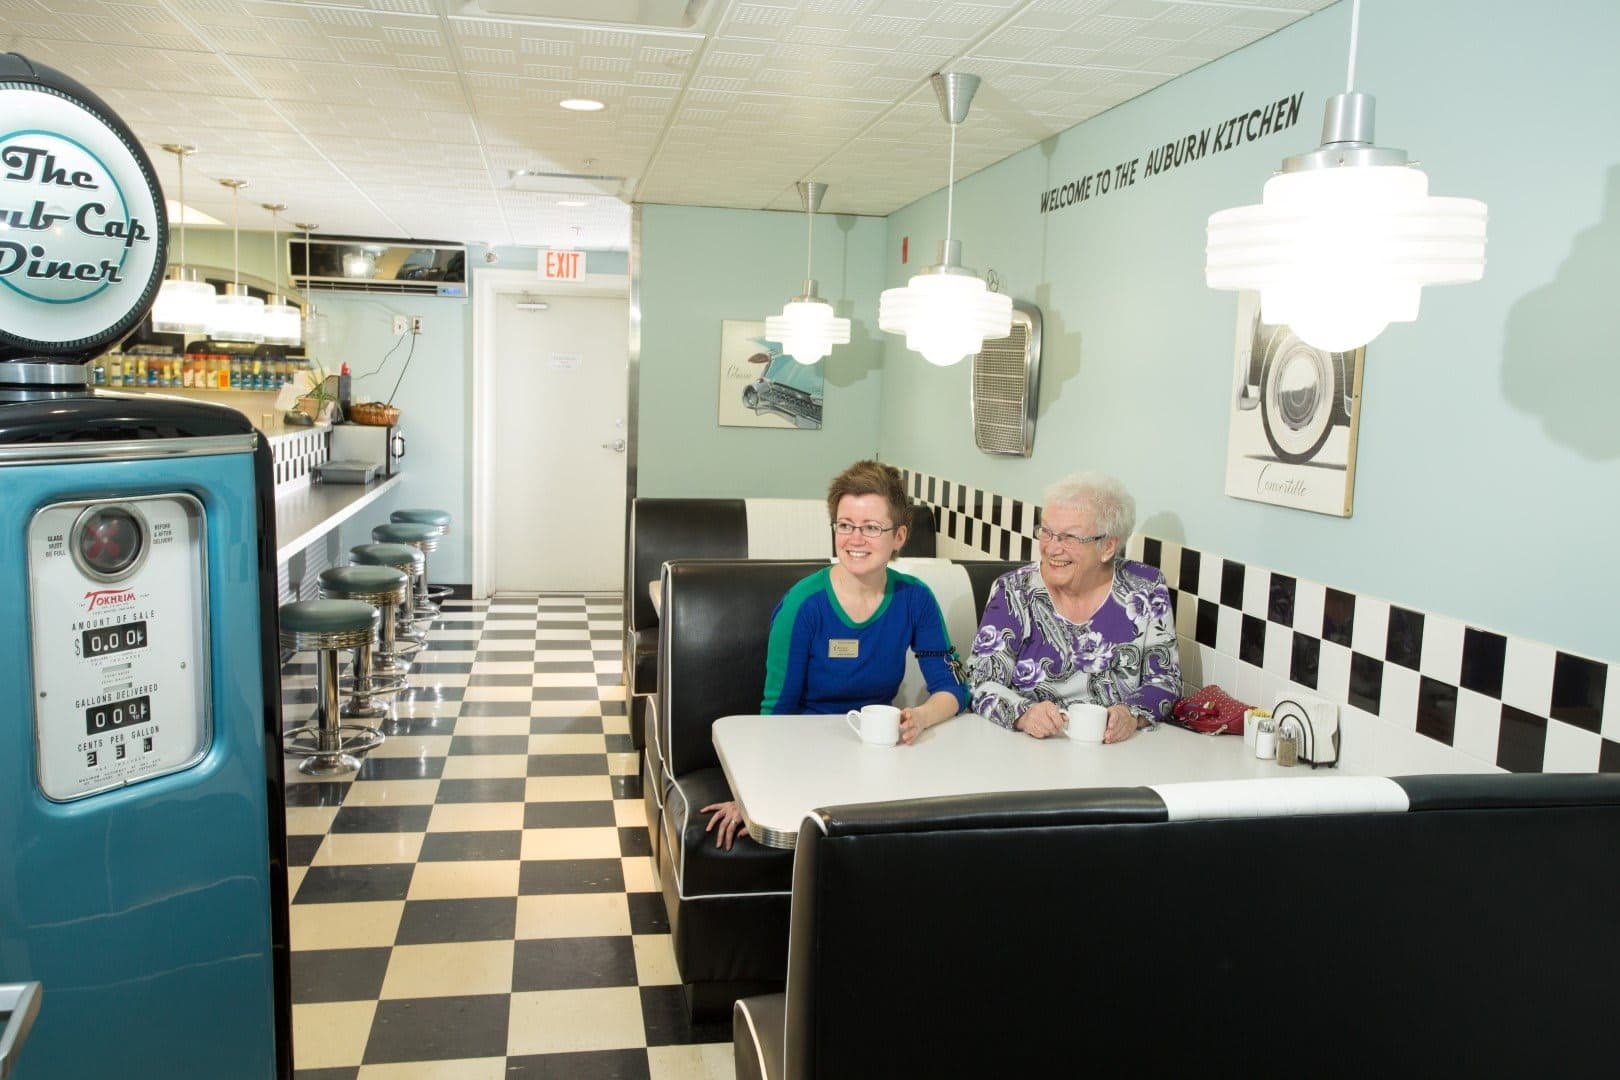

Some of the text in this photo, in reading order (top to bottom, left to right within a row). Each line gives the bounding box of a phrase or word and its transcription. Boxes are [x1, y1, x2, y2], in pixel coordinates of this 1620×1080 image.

[1039, 91, 1304, 214] WELCOME TO THE AUBURN KITCHEN
[2, 146, 99, 189] The
[0, 201, 150, 248] ub Cap
[0, 241, 123, 283] Diner
[546, 252, 580, 279] EXIT
[84, 587, 136, 612] TOKHEIM
[72, 617, 110, 630] AMOUNT
[117, 614, 126, 623] OF
[133, 609, 155, 621] SALE
[75, 683, 158, 708] GALLONS DELIVERED
[78, 725, 160, 752] CENTS PER GALLON
